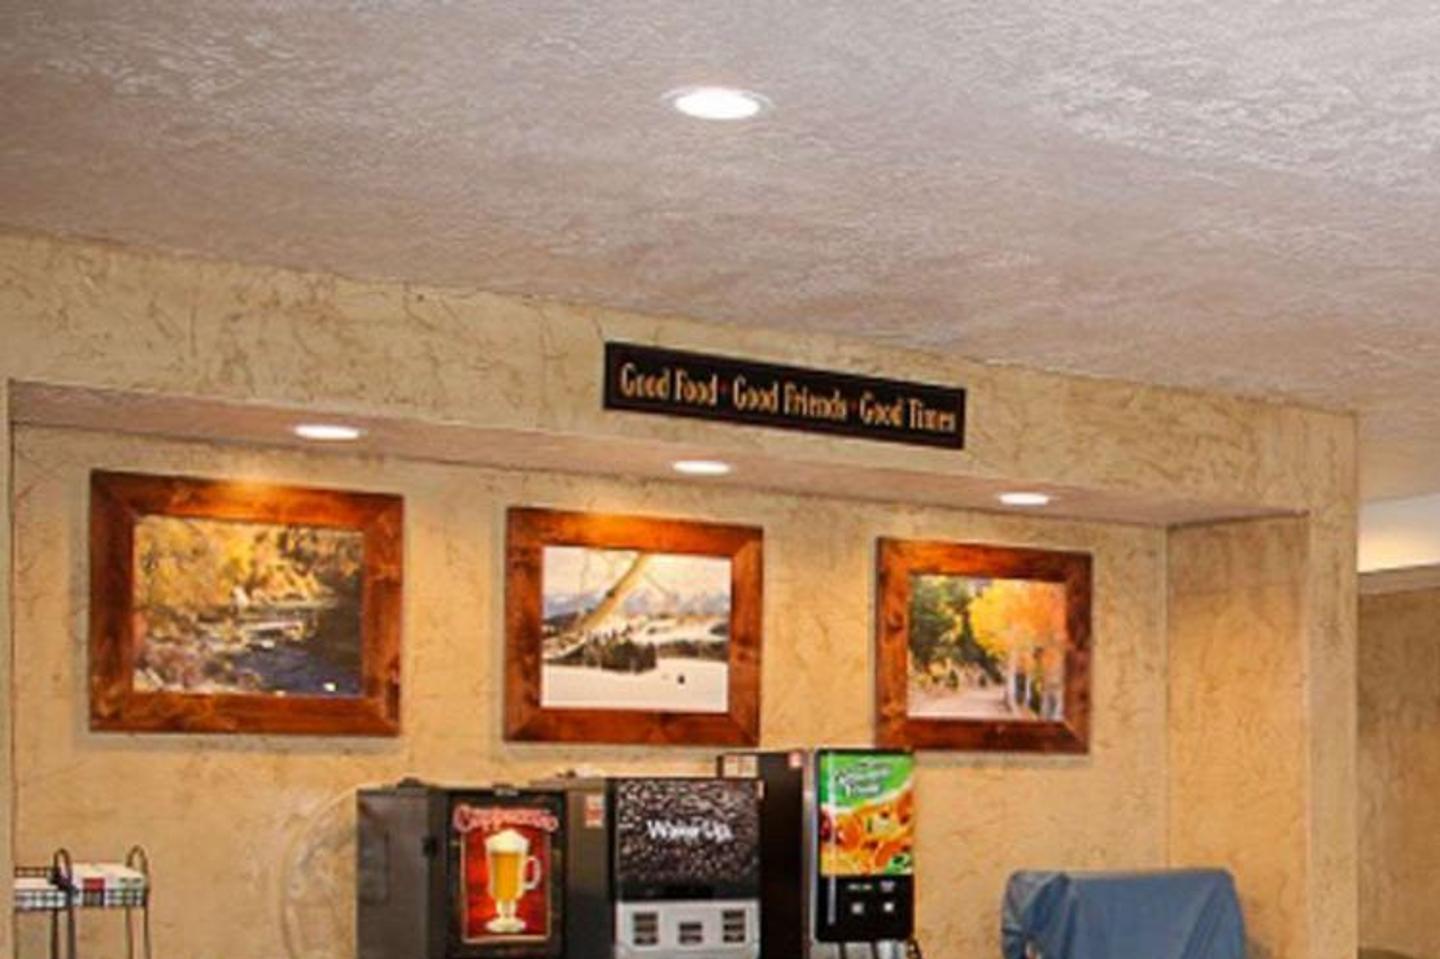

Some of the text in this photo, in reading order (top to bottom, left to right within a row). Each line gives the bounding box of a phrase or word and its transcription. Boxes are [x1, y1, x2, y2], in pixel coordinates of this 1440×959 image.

[620, 361, 957, 432] Good Food Good Friends Good Times
